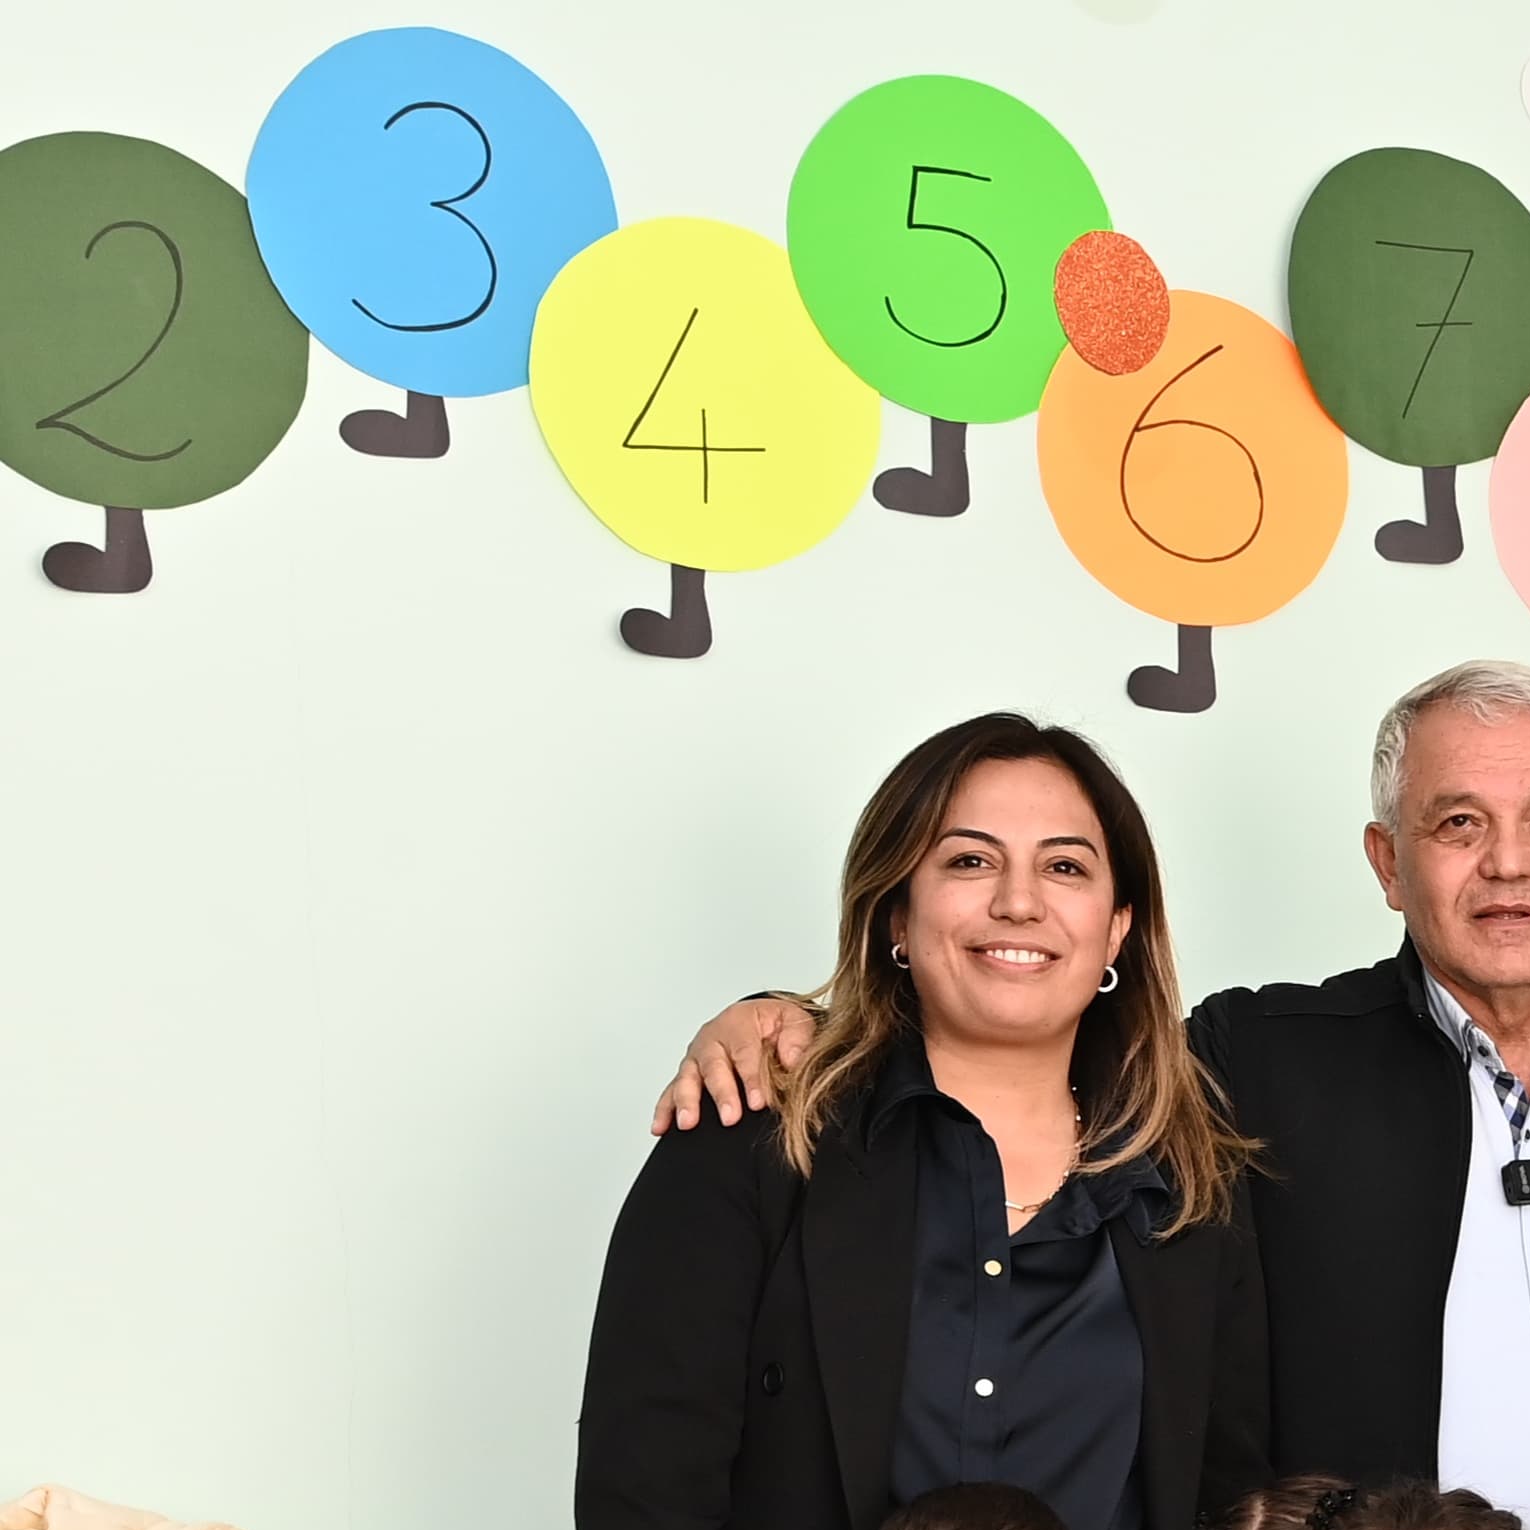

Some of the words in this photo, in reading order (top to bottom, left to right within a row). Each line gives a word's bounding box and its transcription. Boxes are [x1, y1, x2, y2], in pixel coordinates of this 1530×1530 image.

[351, 101, 497, 332] 3
[884, 164, 1007, 347] 5
[35, 220, 192, 462] 2
[622, 307, 766, 504] 4
[1374, 239, 1474, 419] 7
[1119, 344, 1264, 563] 6
